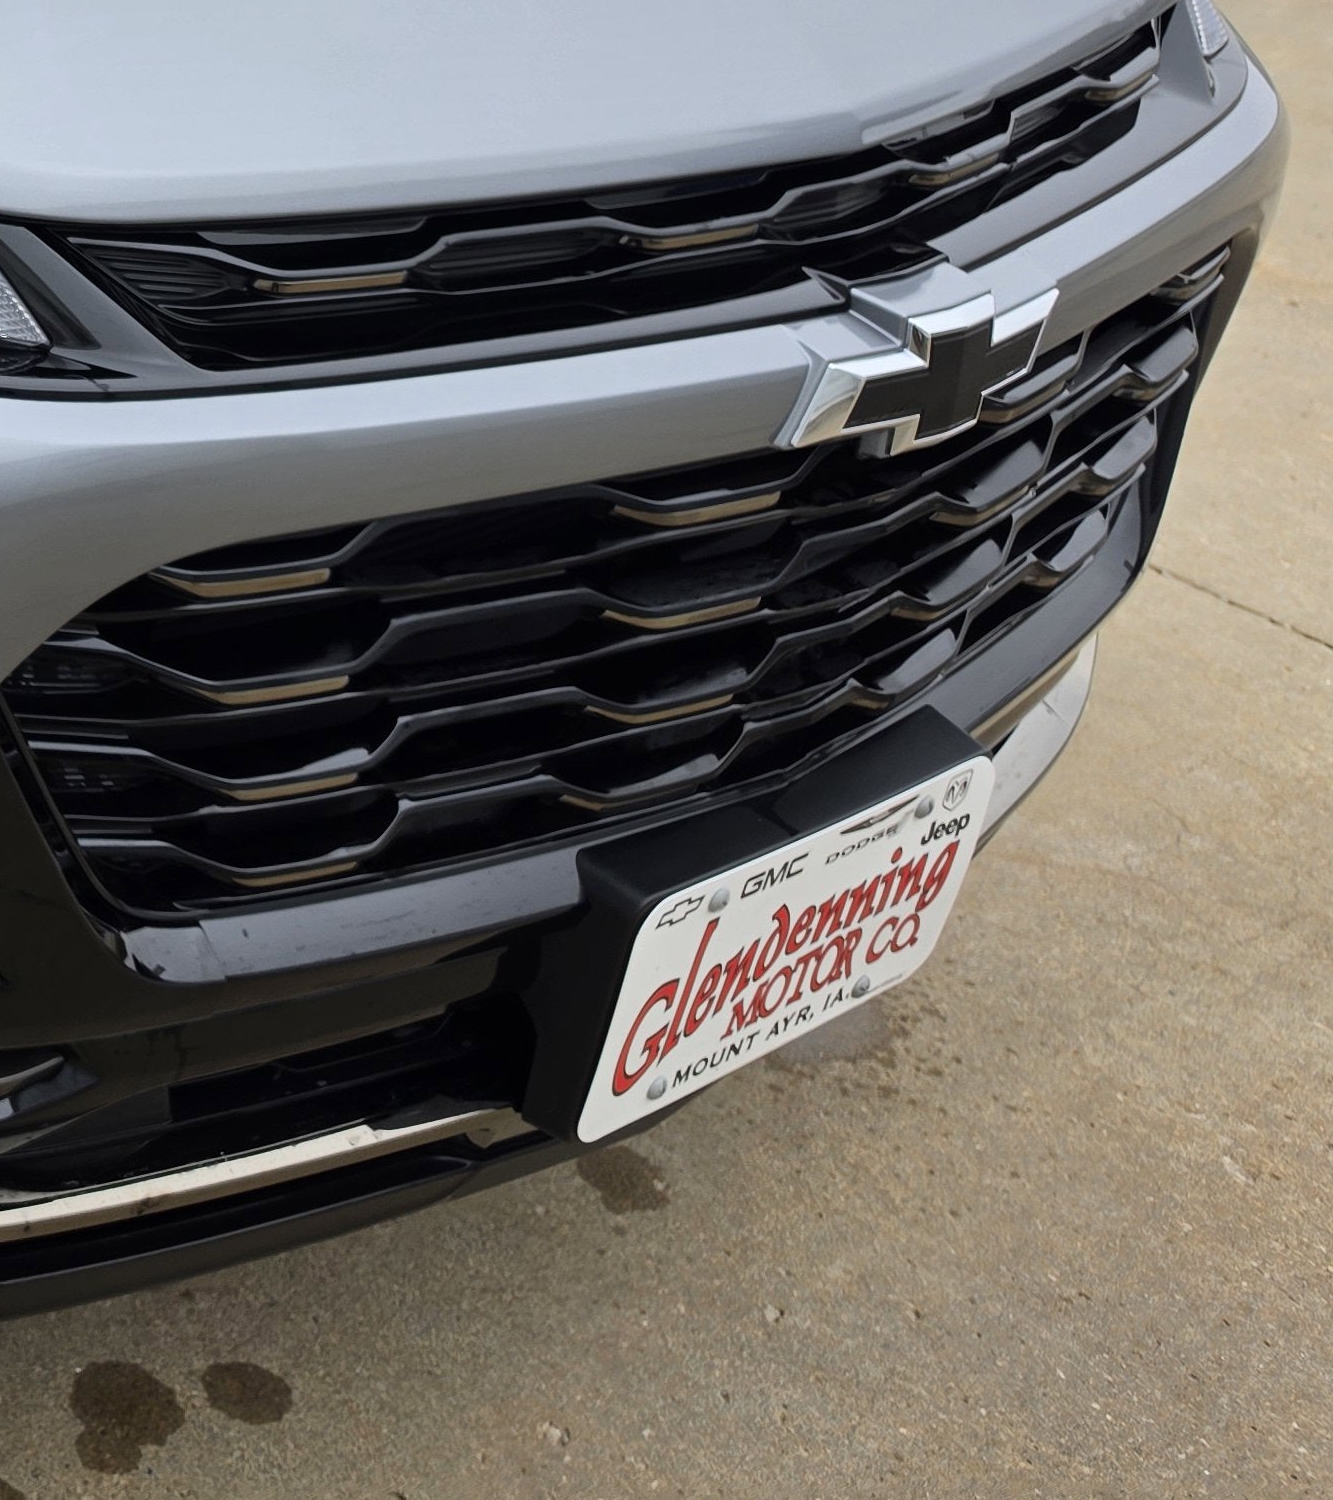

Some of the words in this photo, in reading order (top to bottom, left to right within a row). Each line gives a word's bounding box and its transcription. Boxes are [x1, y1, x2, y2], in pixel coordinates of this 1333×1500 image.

[825, 824, 899, 864] DODGE
[921, 813, 970, 845] Jeep
[741, 853, 809, 899] GMC
[612, 840, 960, 1096] Glendenning
[720, 928, 863, 1040] MOTOR
[672, 1031, 760, 1087] MOUNT
[765, 1006, 814, 1040] AYR,
[822, 988, 850, 1011] IA.
